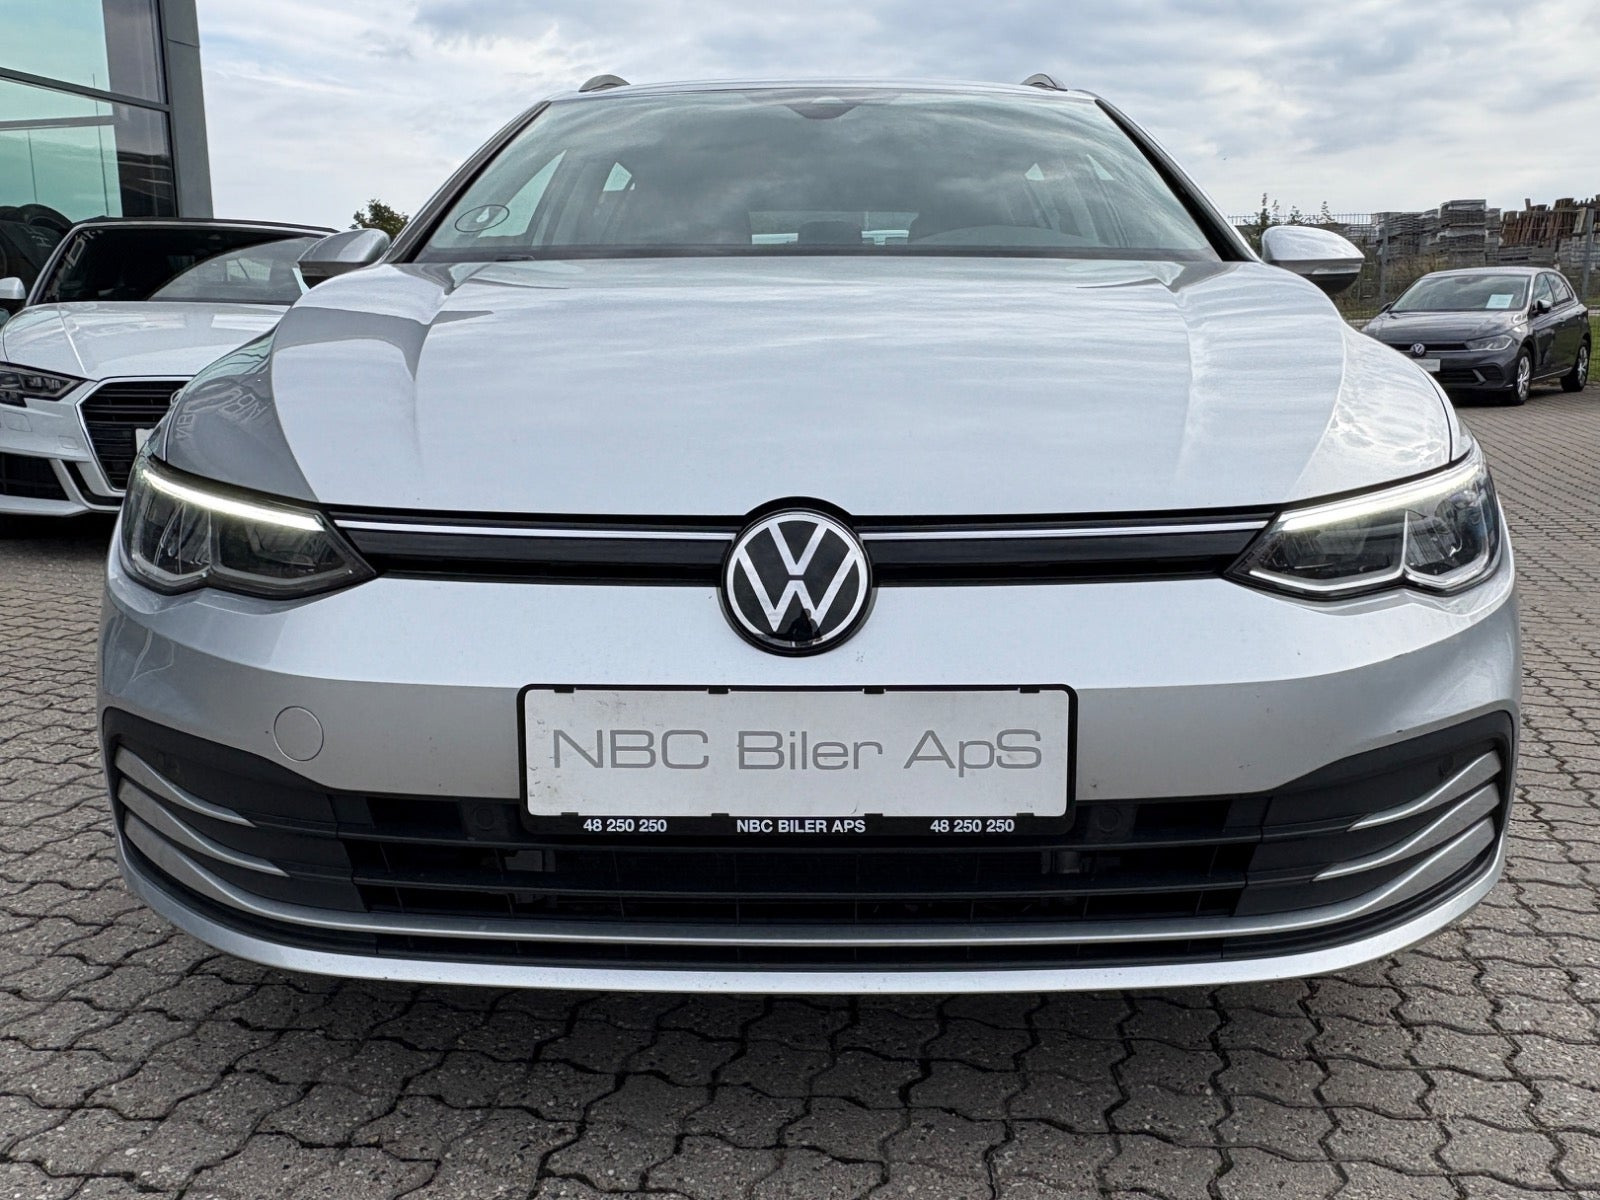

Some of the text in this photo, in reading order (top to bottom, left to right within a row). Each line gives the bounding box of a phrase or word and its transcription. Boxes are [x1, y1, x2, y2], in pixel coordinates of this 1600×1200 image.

[552, 729, 1042, 778] NBC Biler ApS
[583, 818, 667, 832] 48 250 250
[736, 819, 866, 833] NBC BILER APS
[930, 819, 1015, 833] 48 250 250
